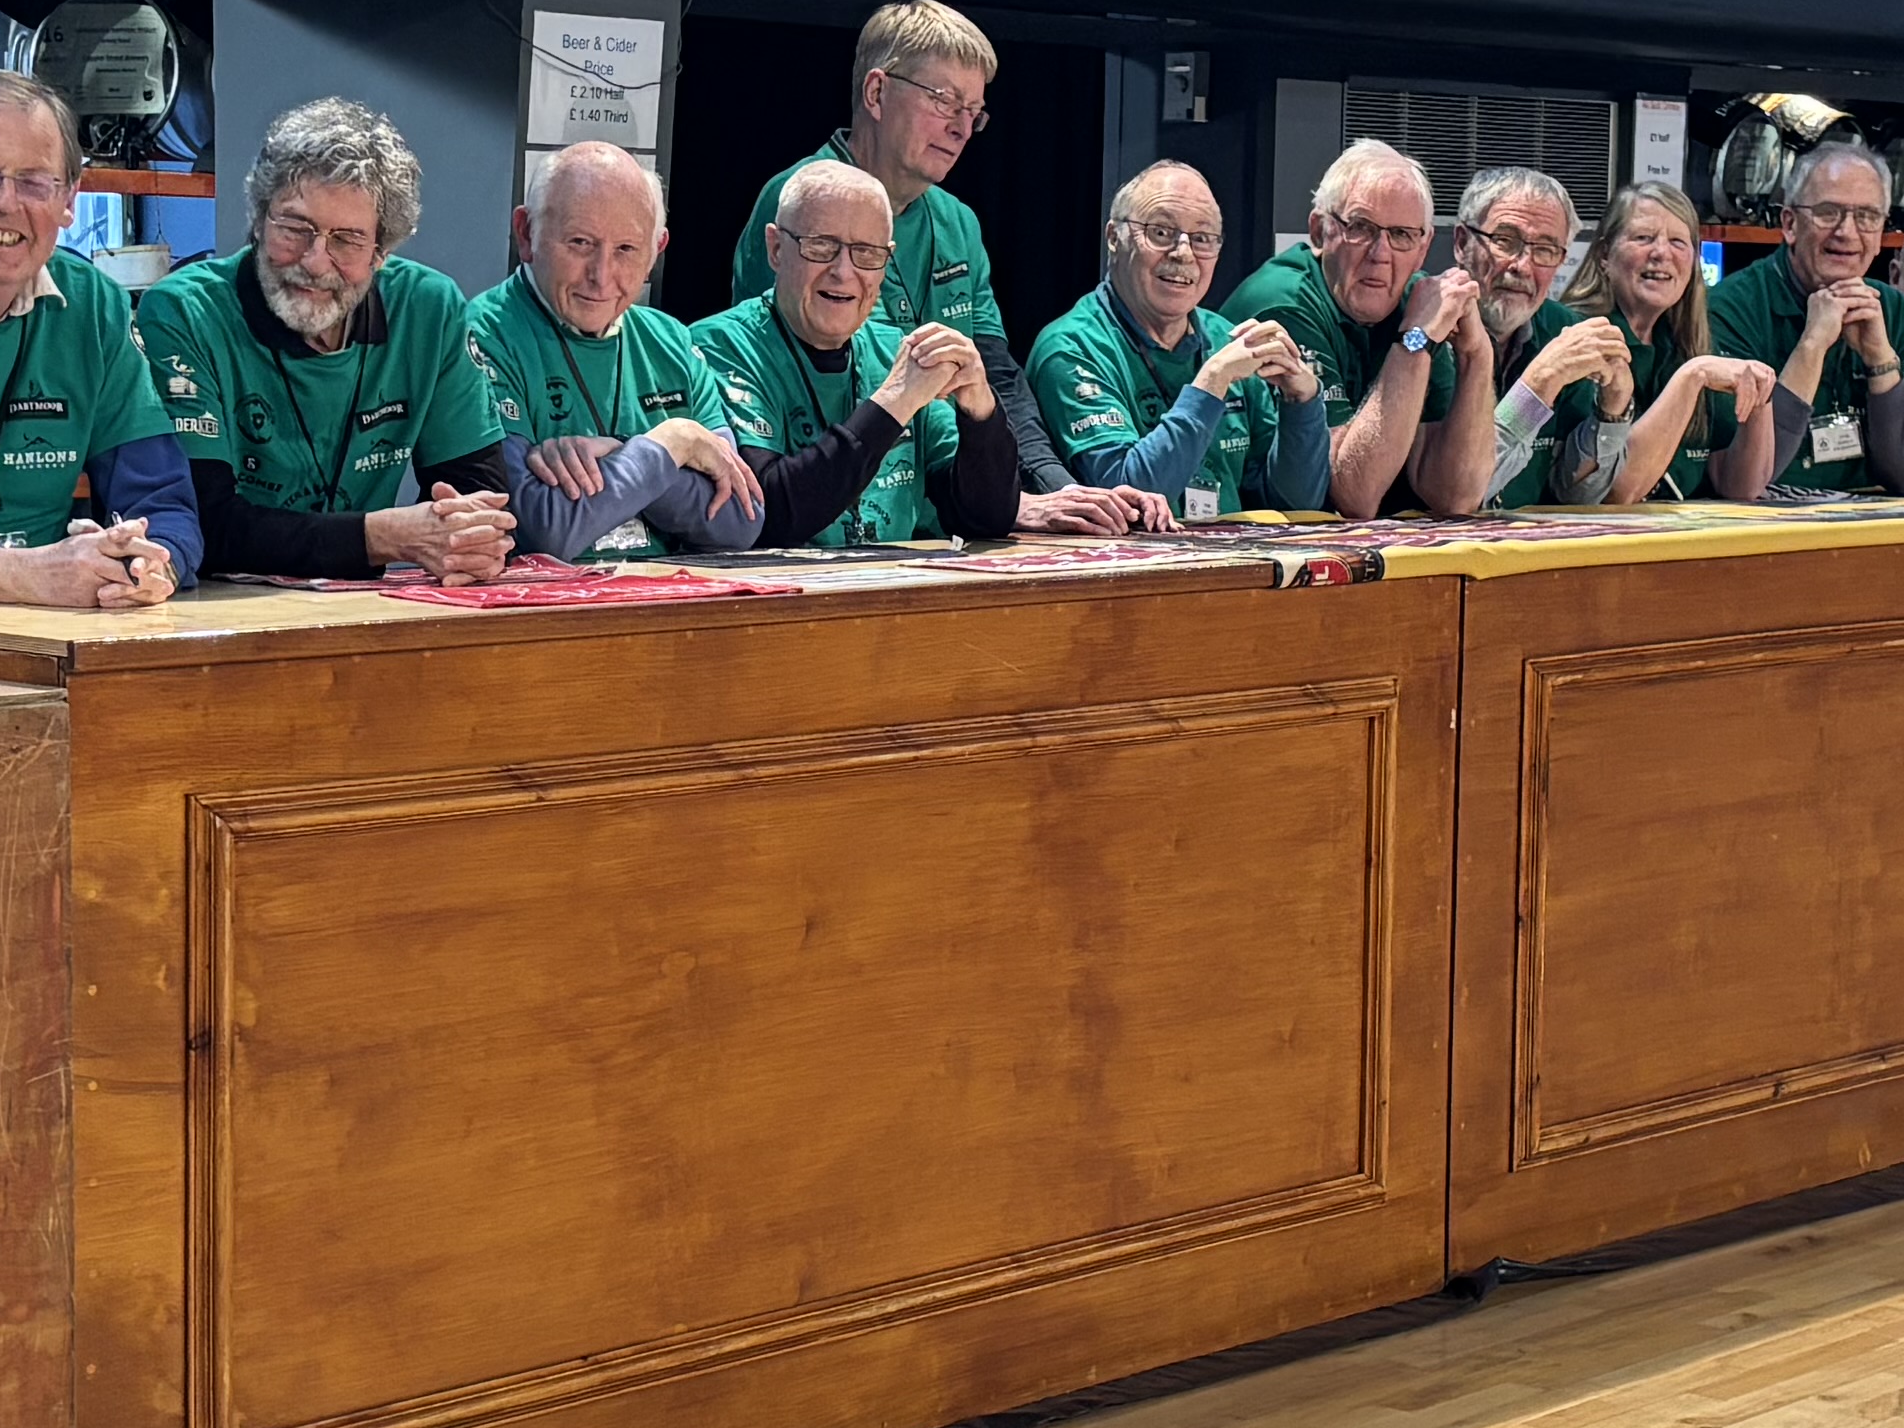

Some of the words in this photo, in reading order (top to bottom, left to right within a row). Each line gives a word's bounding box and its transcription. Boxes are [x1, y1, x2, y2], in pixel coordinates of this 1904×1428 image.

[562, 34, 590, 50] Beer
[594, 36, 601, 51] &
[606, 37, 637, 53] Cider
[584, 60, 614, 75] Price
[580, 86, 602, 100] 2.10
[569, 108, 576, 121] £
[580, 109, 600, 121] 1.40
[604, 109, 628, 123] Third
[4, 451, 77, 466] HANLONS
